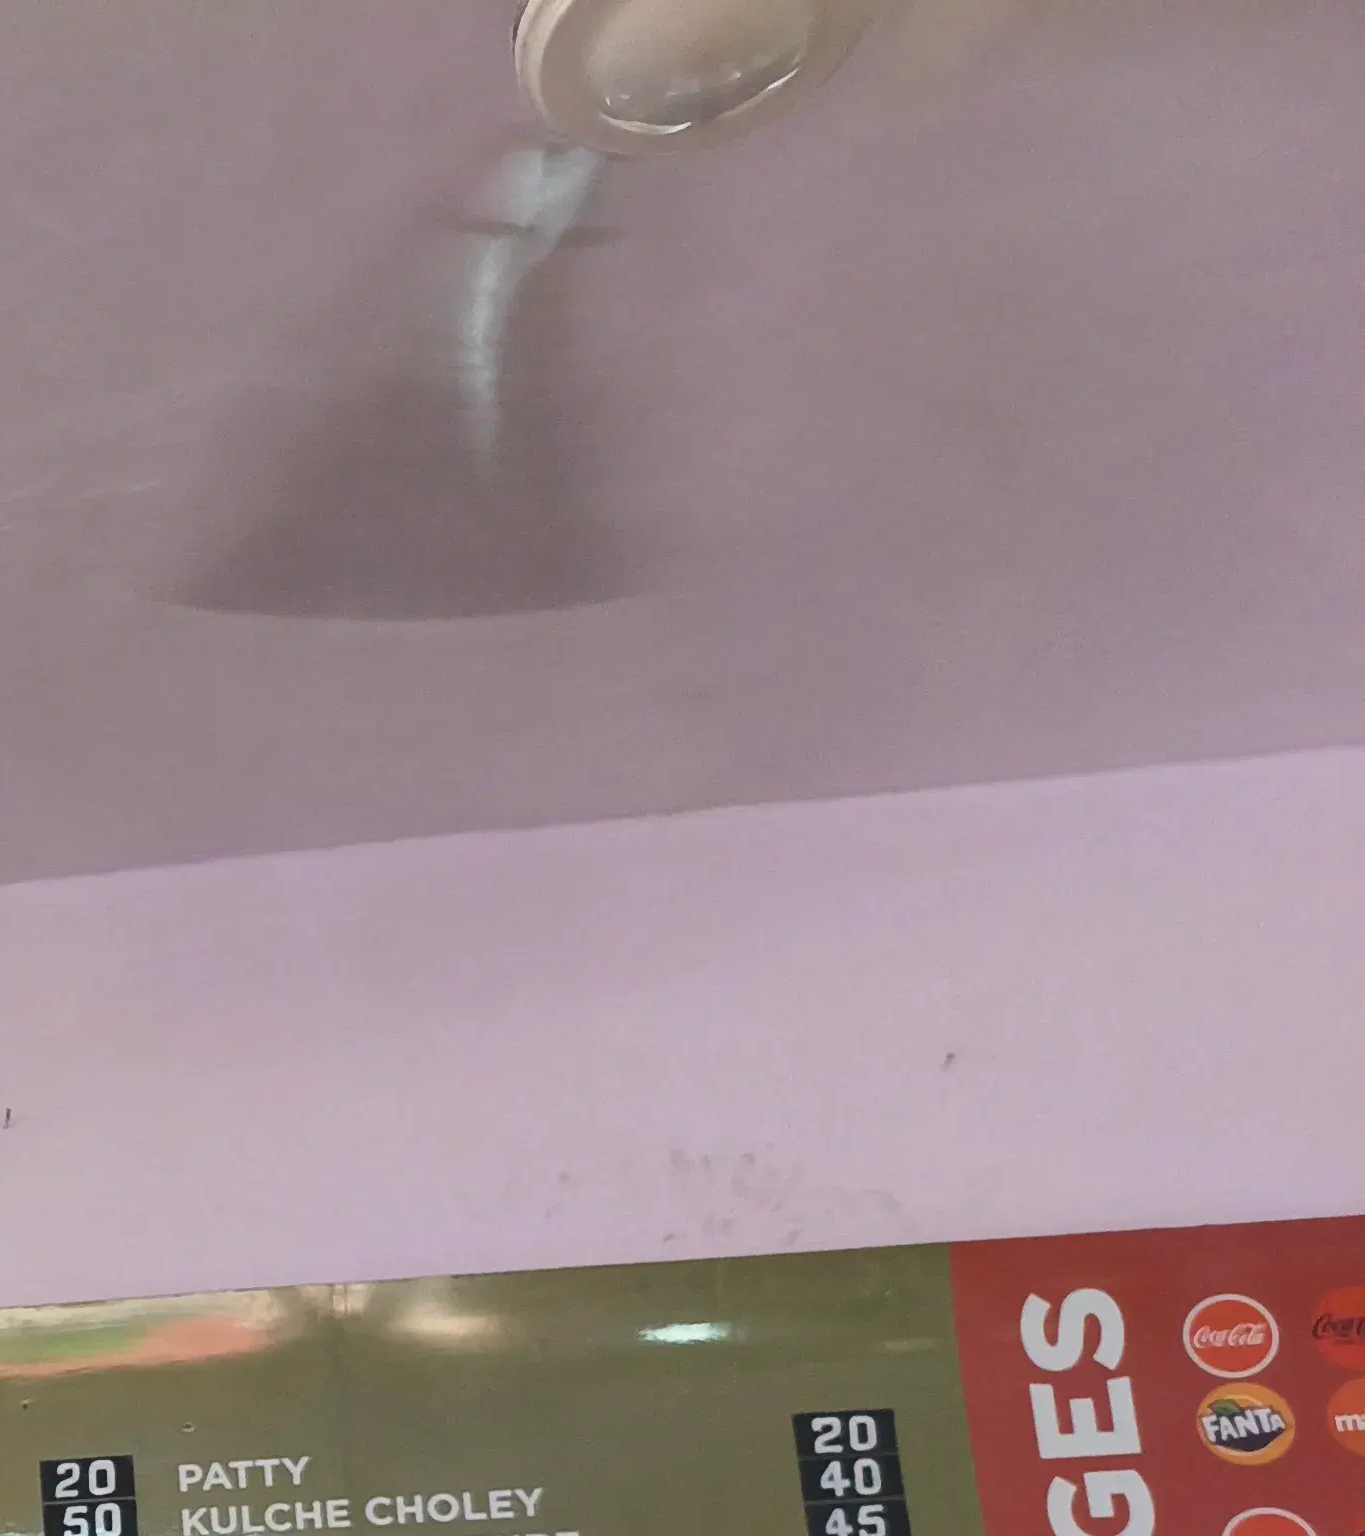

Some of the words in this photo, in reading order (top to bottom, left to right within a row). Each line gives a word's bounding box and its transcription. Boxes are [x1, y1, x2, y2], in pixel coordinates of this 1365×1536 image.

[812, 1416, 876, 1453] 20
[55, 1460, 115, 1497] 20
[180, 1498, 352, 1536] KULCHE
[363, 1490, 542, 1526] CHOLEY
